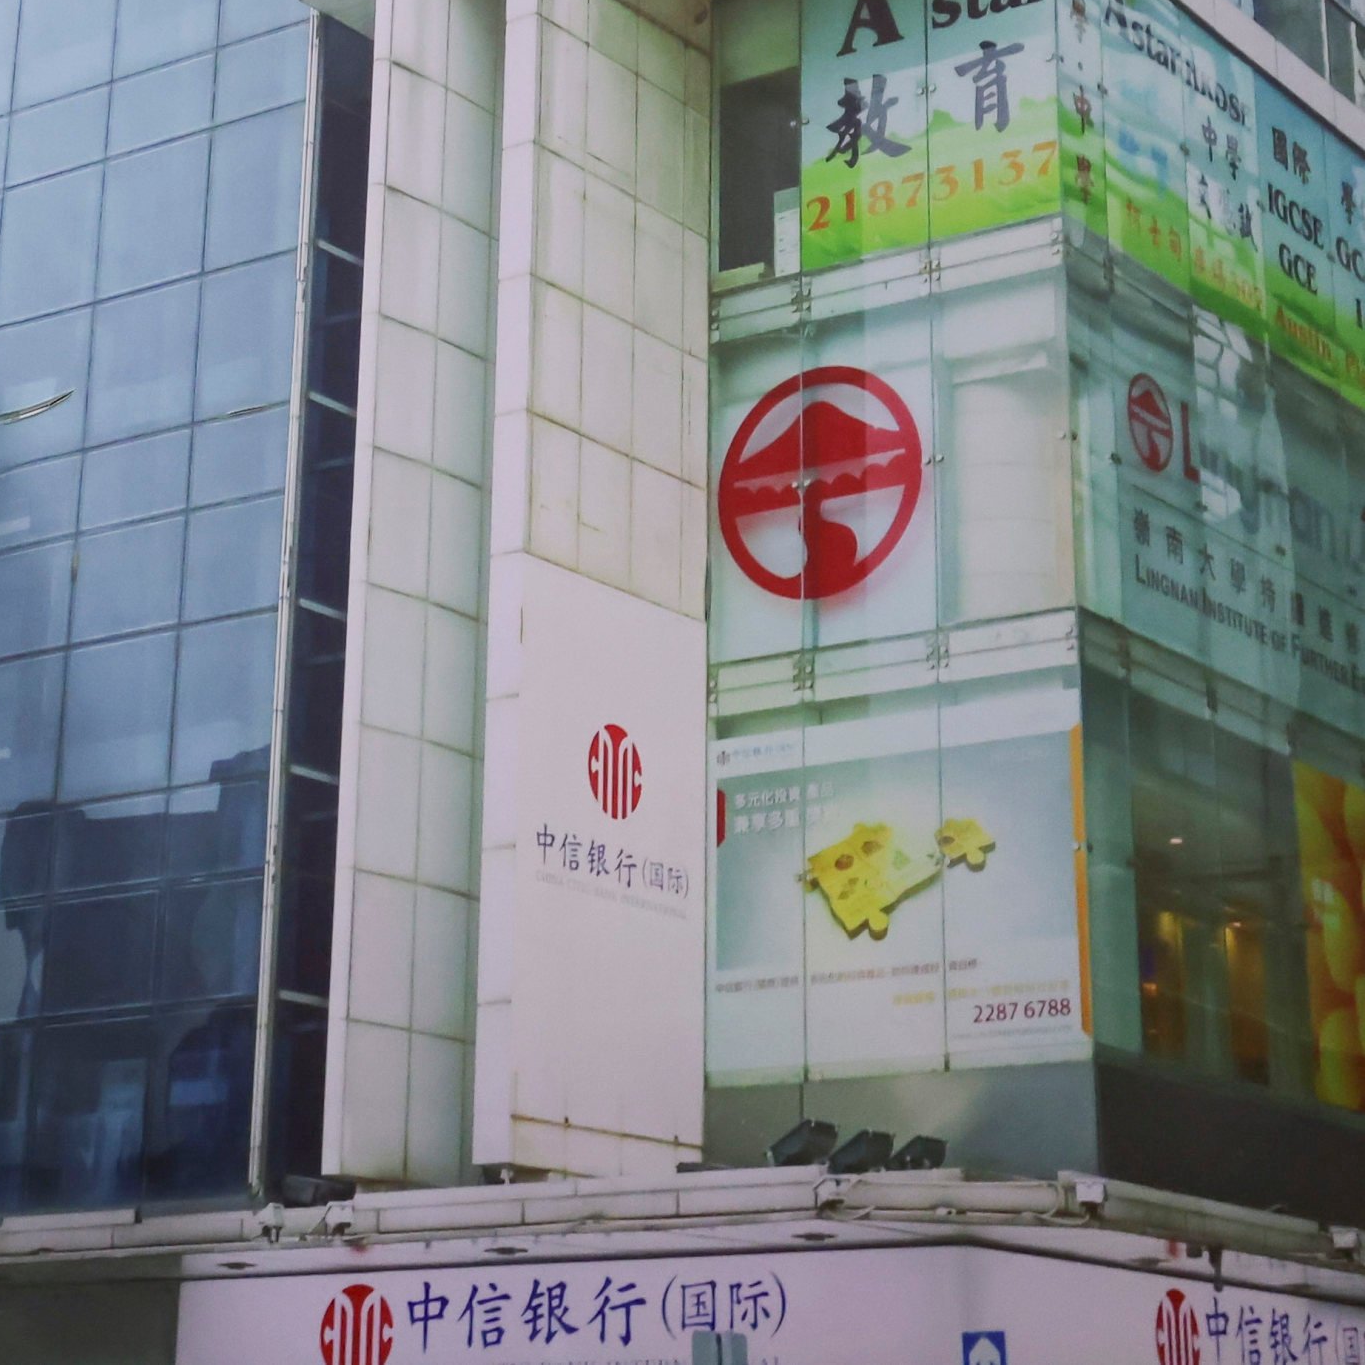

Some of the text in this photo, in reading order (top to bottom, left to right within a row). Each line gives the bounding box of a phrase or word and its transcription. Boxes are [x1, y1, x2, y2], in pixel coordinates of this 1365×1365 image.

[825, 39, 1025, 169] 教育
[806, 140, 1058, 232] 21873137
[1267, 181, 1325, 251] IGCSE
[1279, 242, 1318, 296] GCE
[535, 823, 689, 899] 中信银行(国际)
[973, 997, 1071, 1024] 2287 6788
[407, 1271, 788, 1353] 中信银行(国际)
[1205, 1296, 1365, 1365] 中信银行(国
